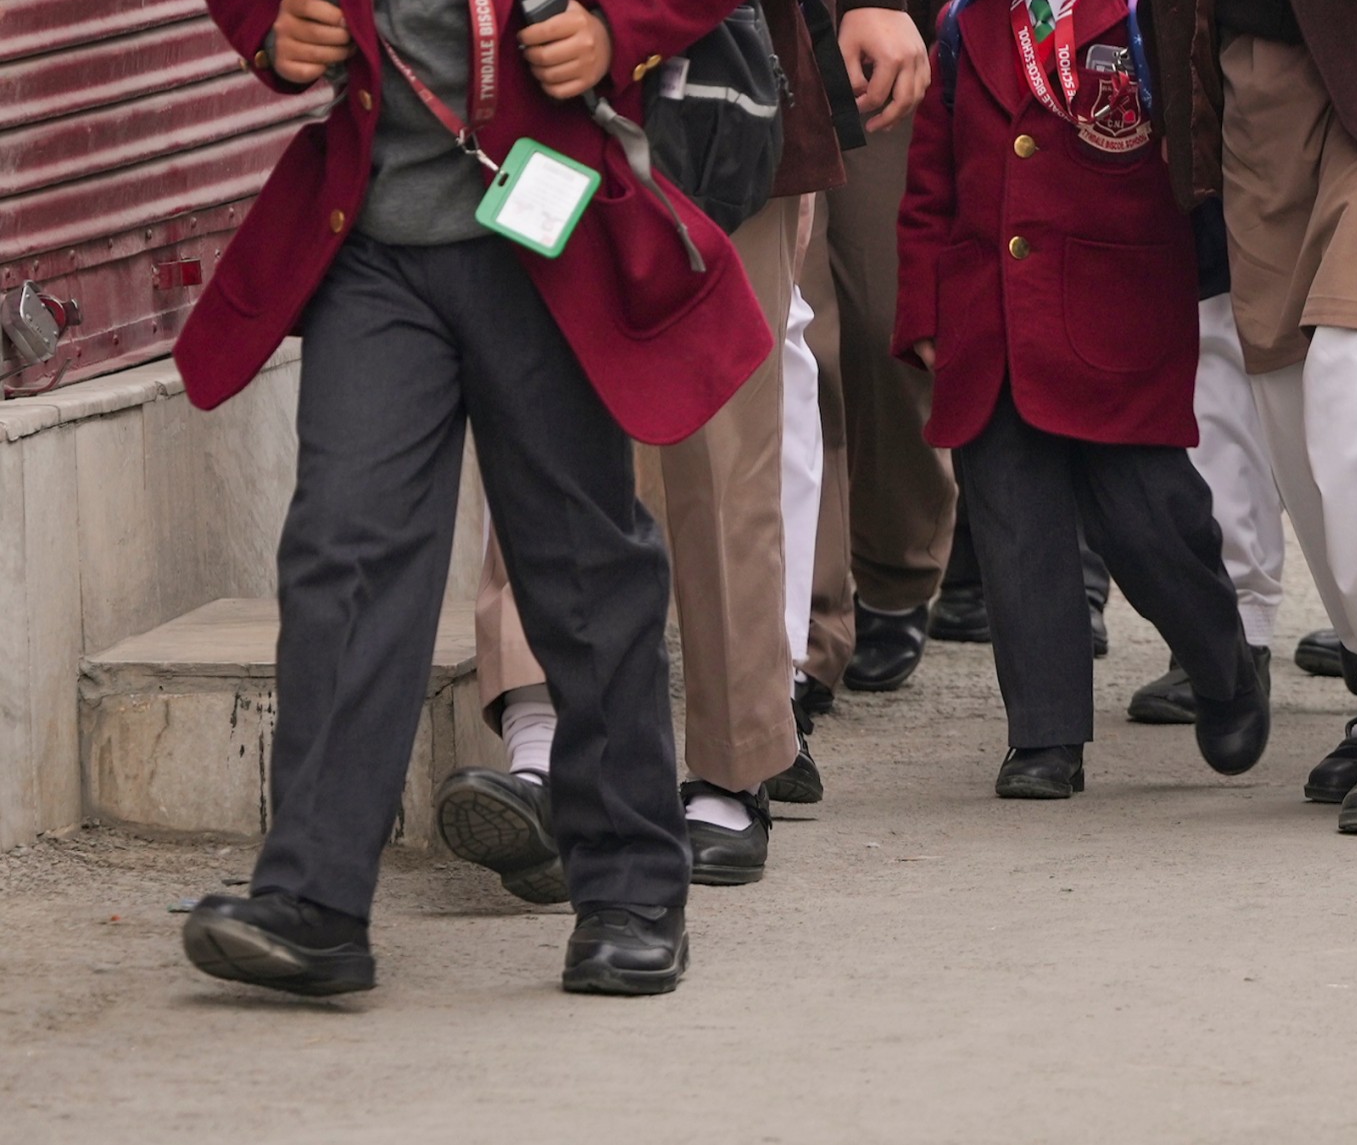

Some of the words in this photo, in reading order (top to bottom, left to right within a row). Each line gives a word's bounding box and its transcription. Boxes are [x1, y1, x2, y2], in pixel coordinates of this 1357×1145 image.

[1018, 26, 1035, 67] SCHOOL
[1058, 44, 1076, 89] SCHOOL
[480, 40, 496, 100] TYNDALE
[1025, 59, 1046, 101] BISCOE
